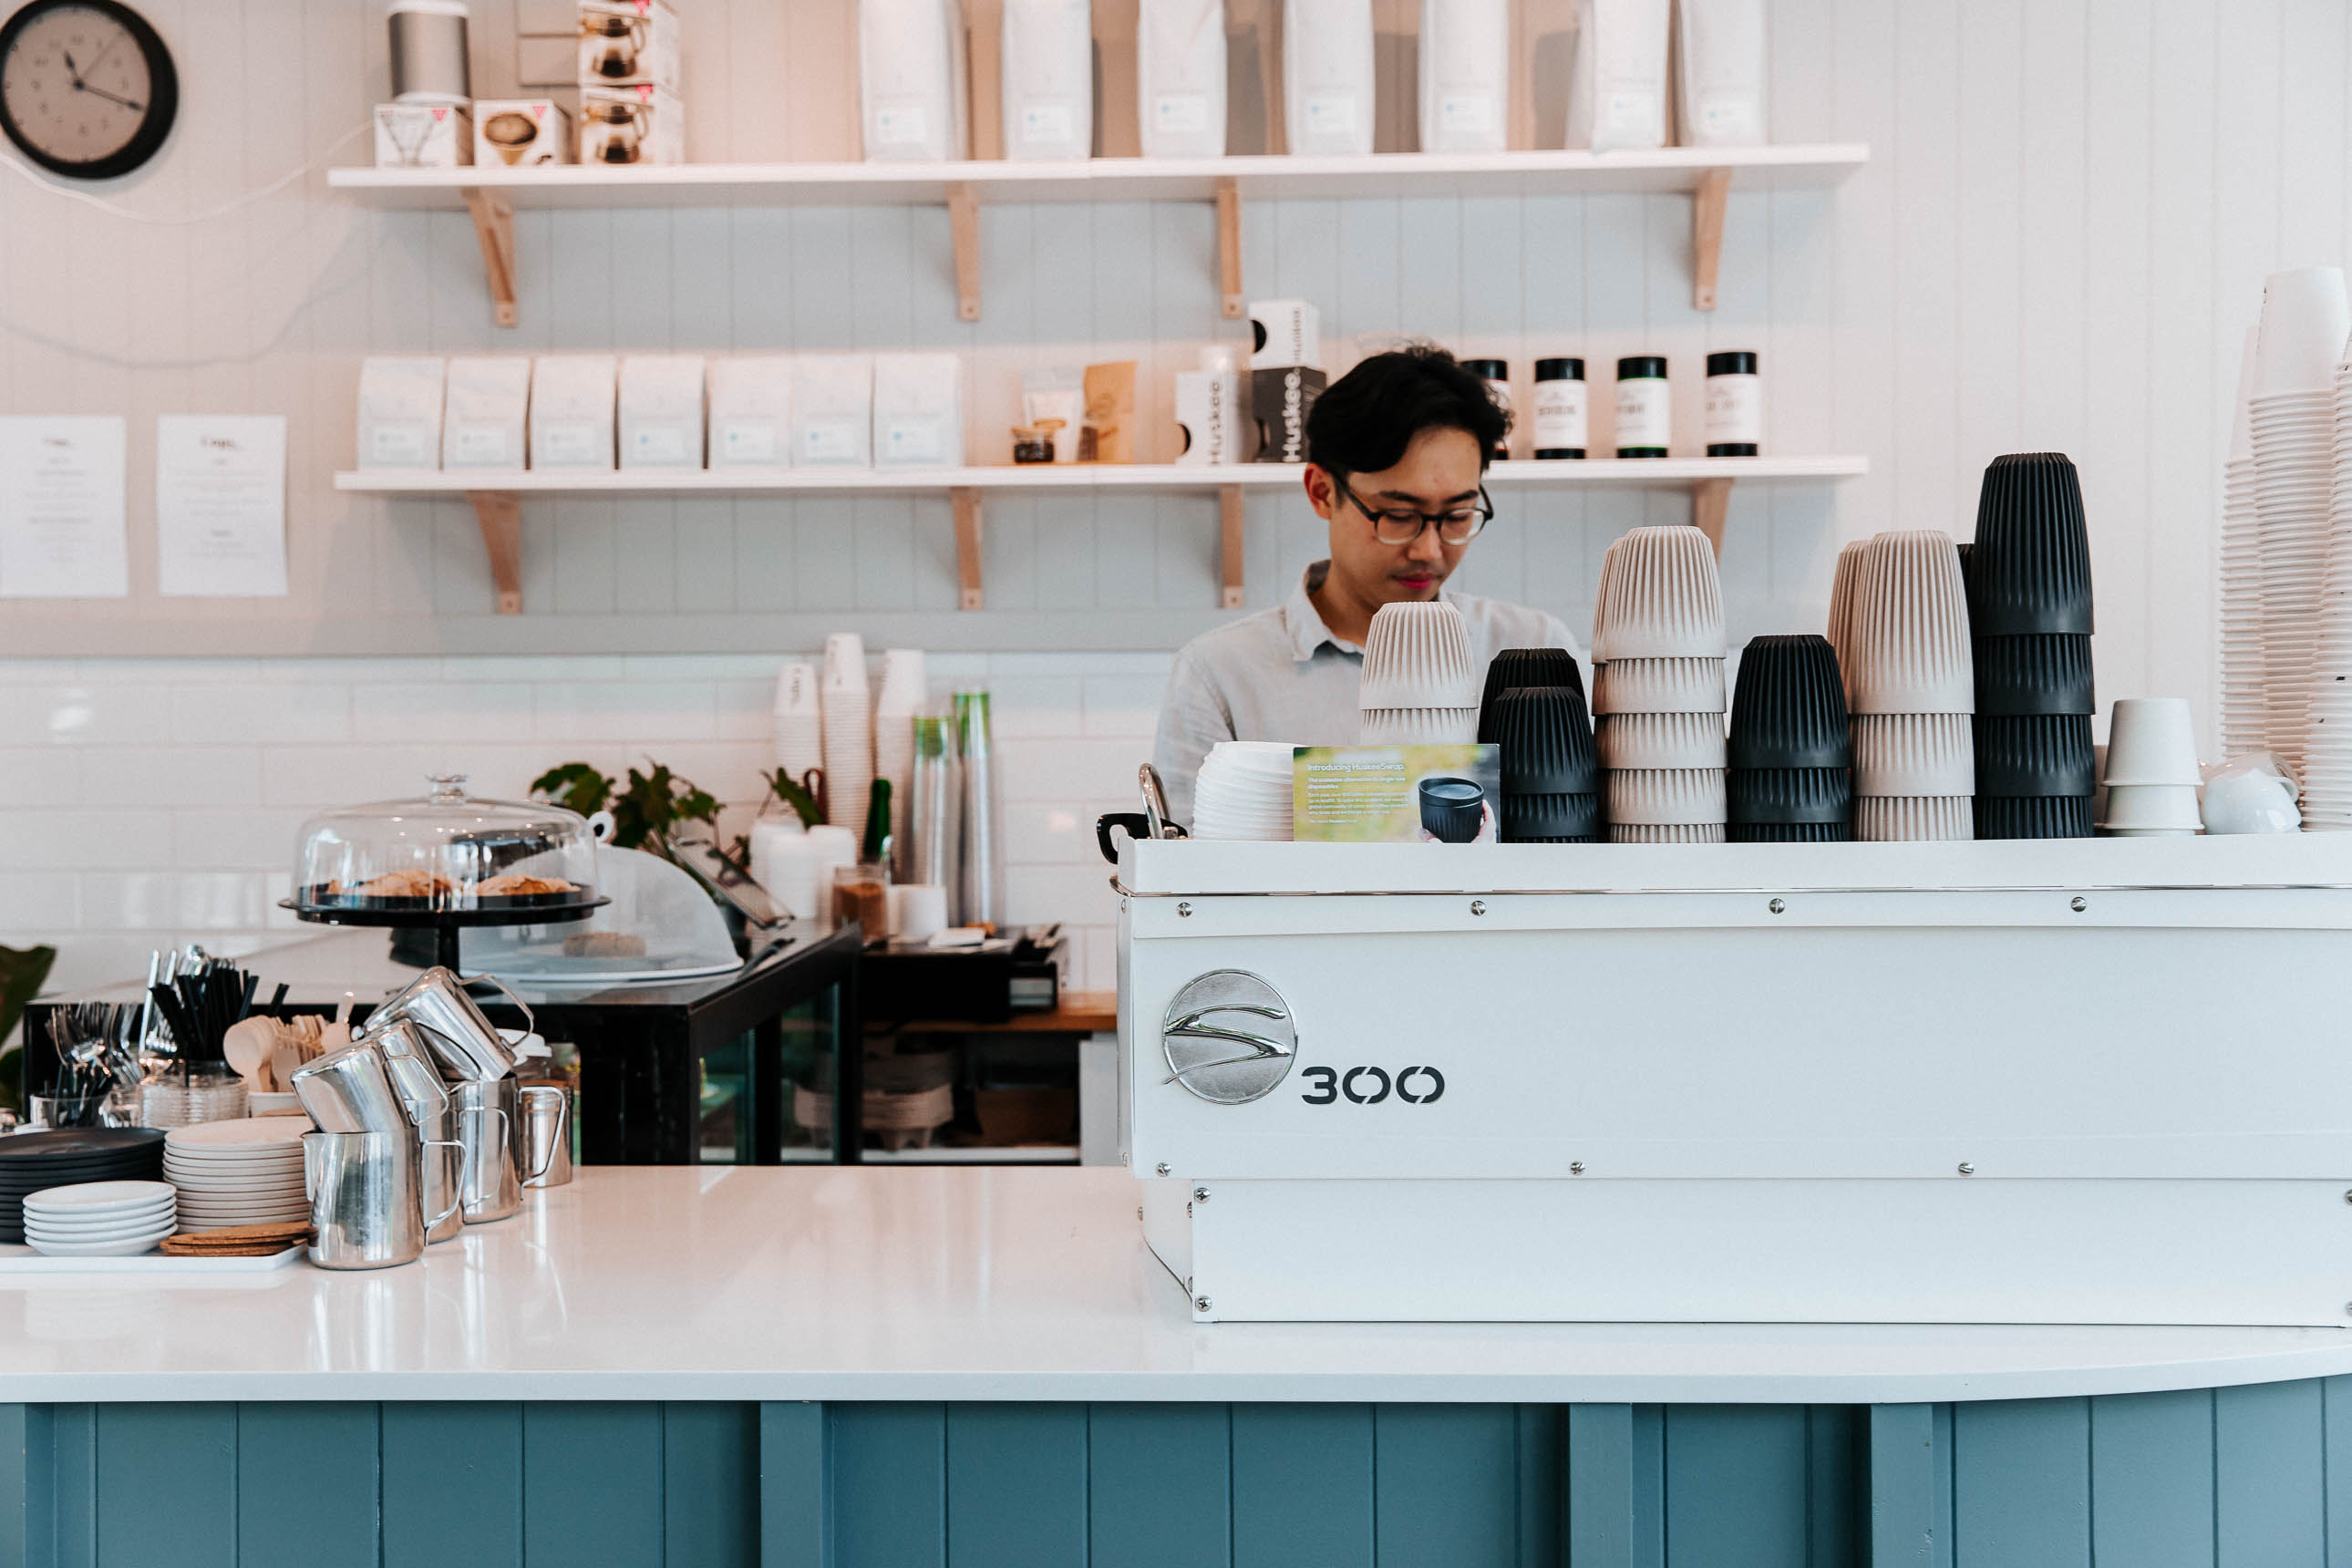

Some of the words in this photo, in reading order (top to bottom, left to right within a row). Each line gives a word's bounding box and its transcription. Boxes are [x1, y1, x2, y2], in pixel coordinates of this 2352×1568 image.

[1282, 372, 1302, 463] Huskee
[1307, 763, 1351, 773] Introducing
[1301, 1066, 1446, 1105] 300
